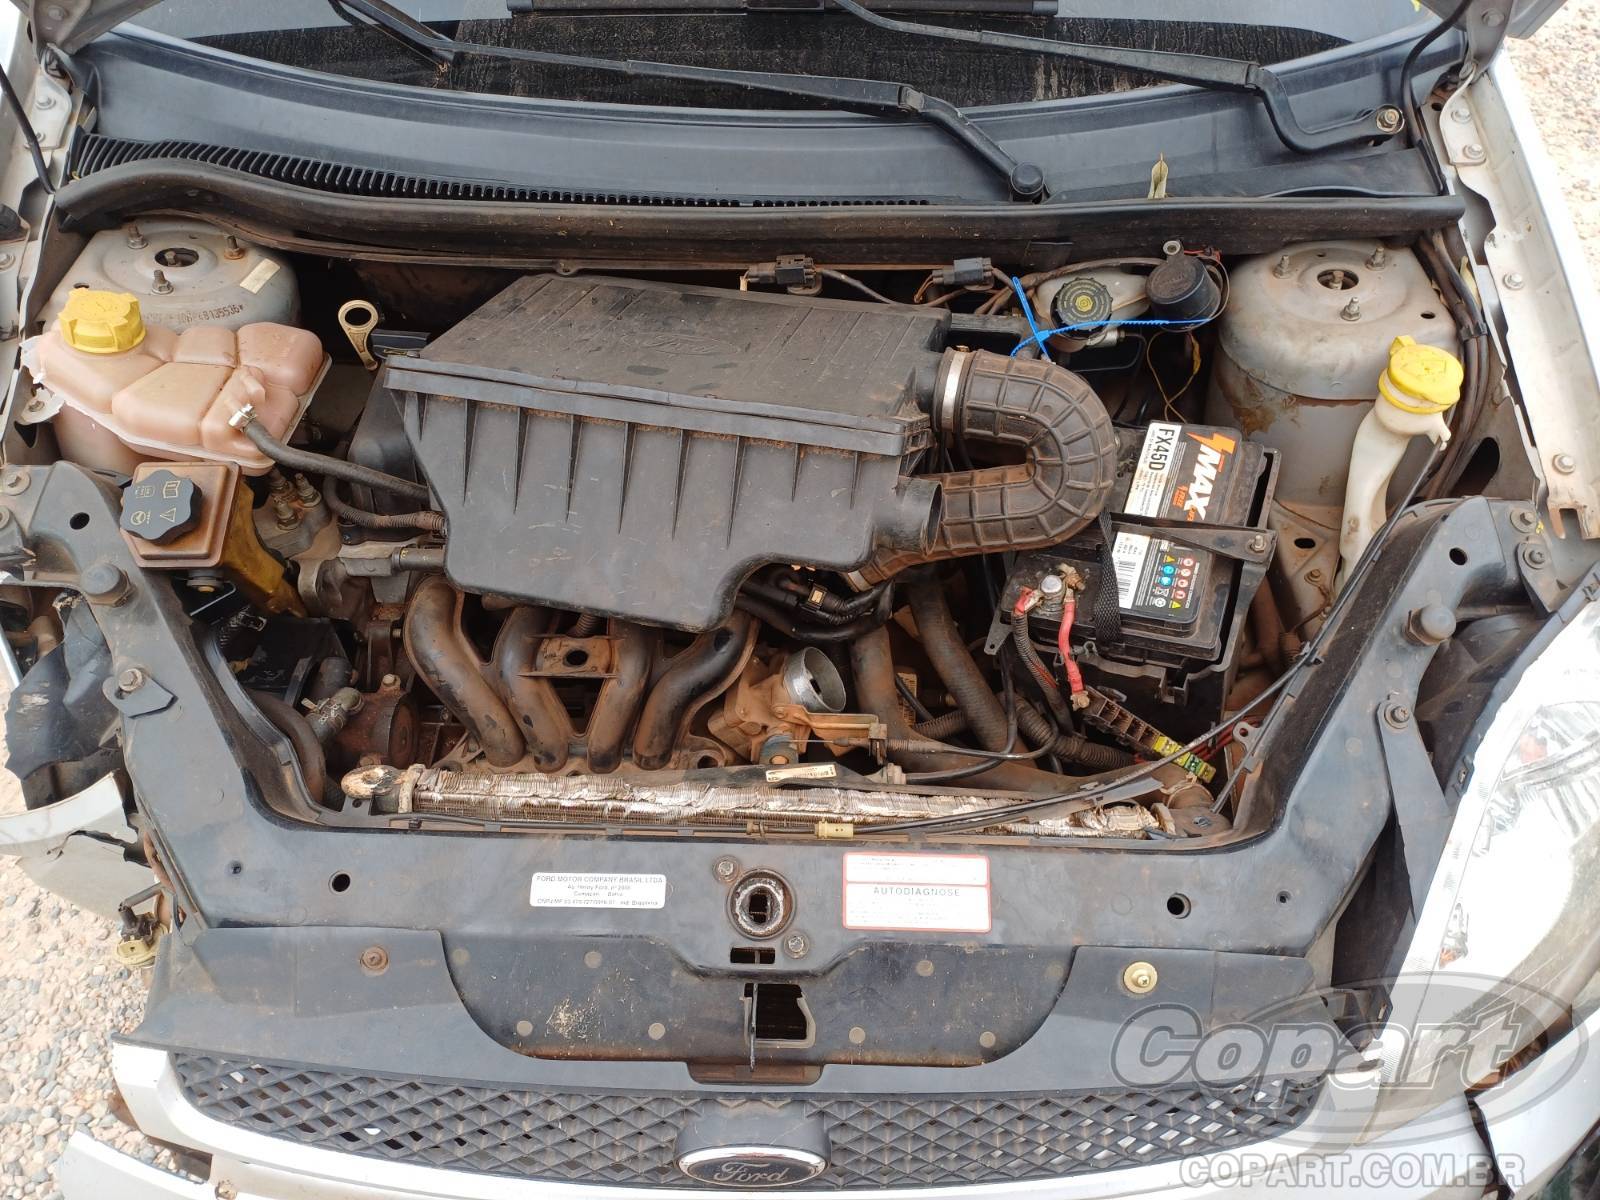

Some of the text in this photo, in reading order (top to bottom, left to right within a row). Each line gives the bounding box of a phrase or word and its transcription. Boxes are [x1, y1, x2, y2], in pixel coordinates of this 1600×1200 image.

[1148, 428, 1175, 471] FX45D
[584, 876, 618, 884] COMPANY
[873, 886, 961, 897] AUTODIAGNOSE
[713, 1161, 790, 1183] Ford
